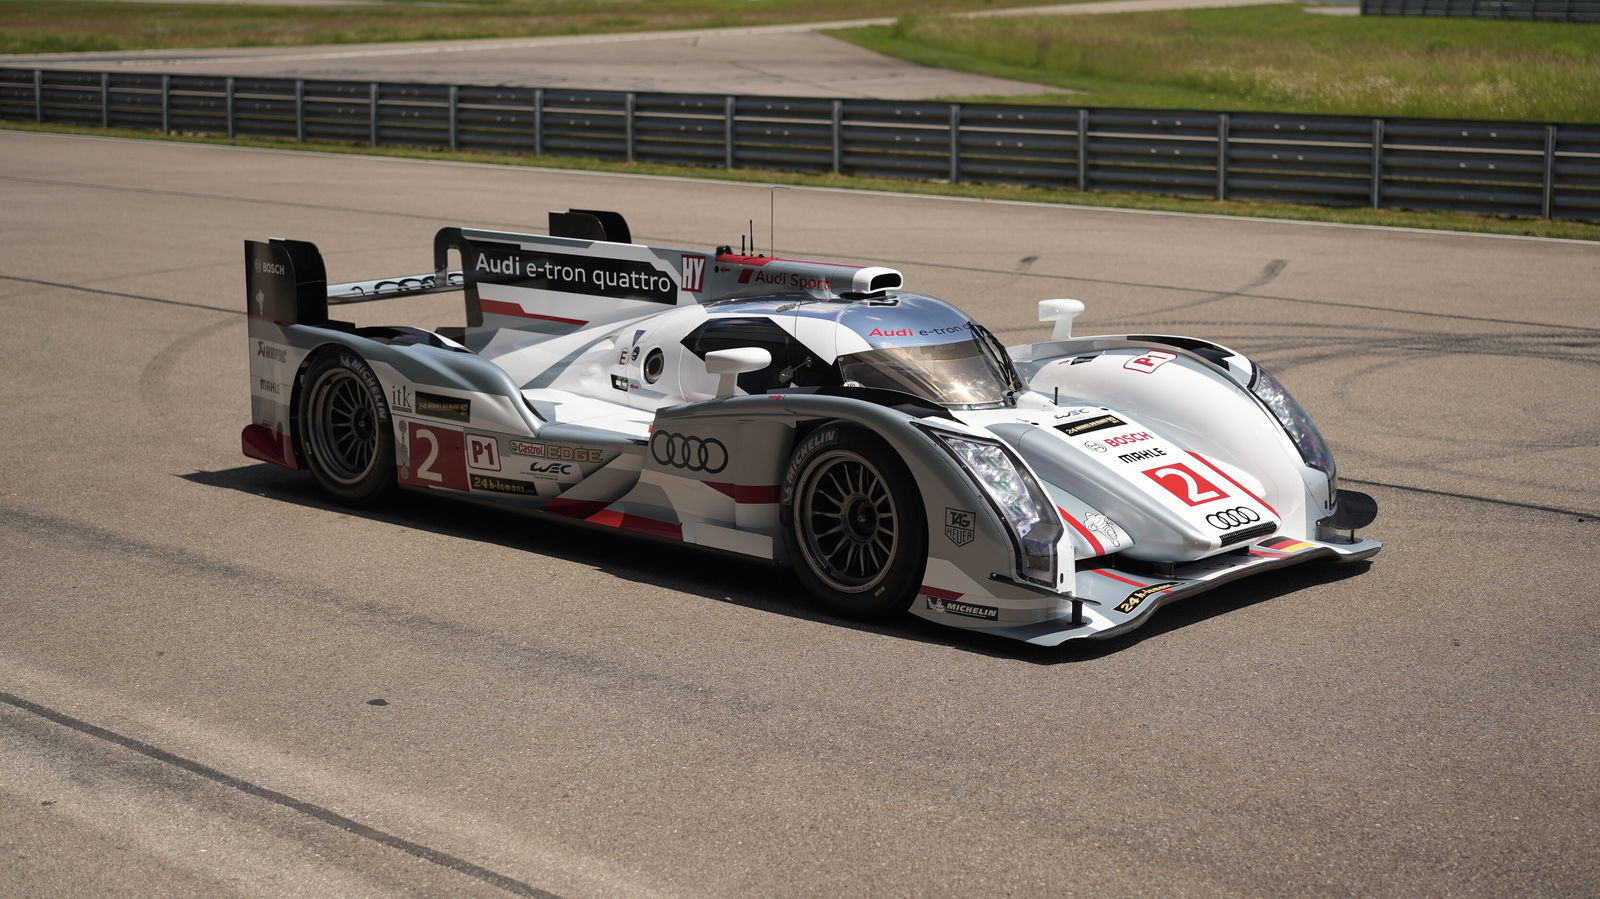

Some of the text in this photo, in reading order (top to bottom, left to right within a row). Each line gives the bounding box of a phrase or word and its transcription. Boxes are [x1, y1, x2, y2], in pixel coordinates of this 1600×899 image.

[262, 262, 285, 276] BOSCH
[475, 253, 671, 293] Audi e-tron quattro
[682, 257, 705, 290] HY
[755, 271, 830, 291] Audi Sport
[868, 328, 915, 337] Audi
[919, 325, 962, 337] e-tron
[1133, 354, 1167, 367] P1
[260, 379, 281, 395] MAHLE
[351, 360, 388, 421] MICHELIN
[391, 385, 411, 407] itk
[1103, 431, 1154, 448] BOSCH
[415, 428, 443, 482] 2
[472, 440, 495, 466] P1
[518, 443, 604, 463] Castrol EDGE
[786, 430, 836, 483] MICHELIN
[1118, 447, 1168, 464] MAHLE
[1154, 467, 1221, 503] 2
[950, 511, 971, 528] TAG
[946, 528, 974, 545] HEUER
[946, 602, 998, 617] MICHELIN
